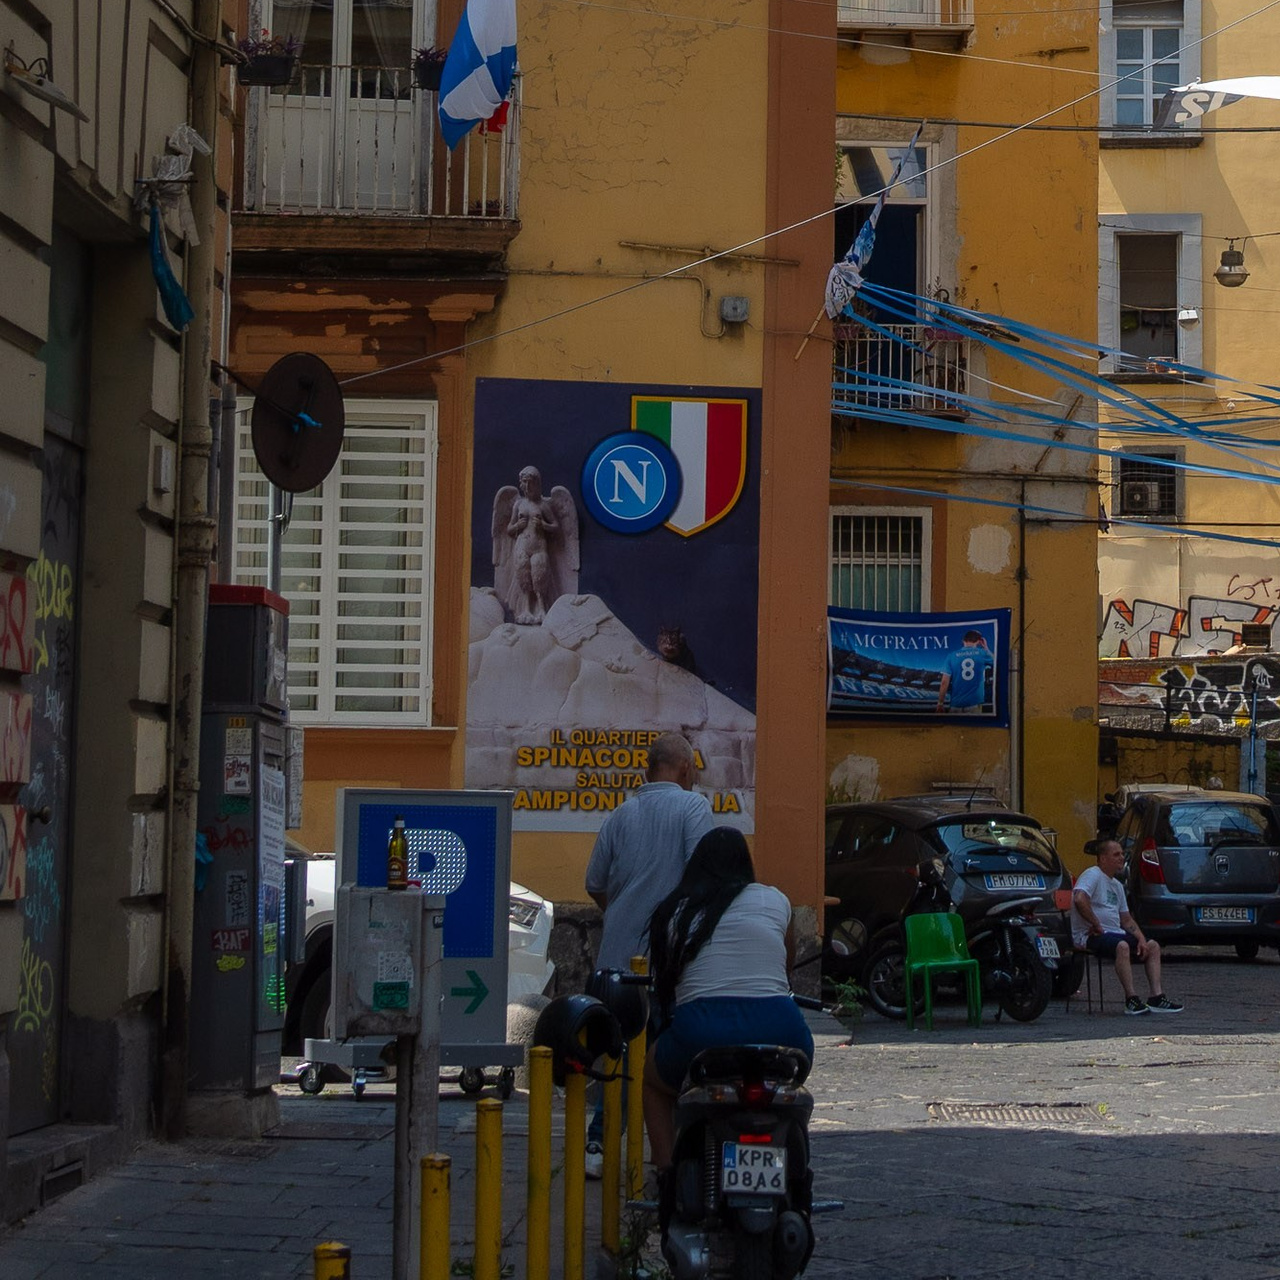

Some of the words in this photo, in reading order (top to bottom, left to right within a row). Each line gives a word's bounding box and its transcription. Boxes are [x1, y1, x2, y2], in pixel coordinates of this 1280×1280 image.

[609, 459, 652, 505] N
[854, 633, 949, 650] MCFRATM
[961, 658, 975, 681] 8
[551, 730, 565, 744] IL
[570, 730, 671, 746] QUARTIER
[576, 772, 643, 788] SALUTA
[513, 790, 625, 811] AMPIONI
[724, 1158, 736, 1167] PL
[738, 1149, 774, 1167] KPR
[727, 1171, 781, 1188] 08A6
